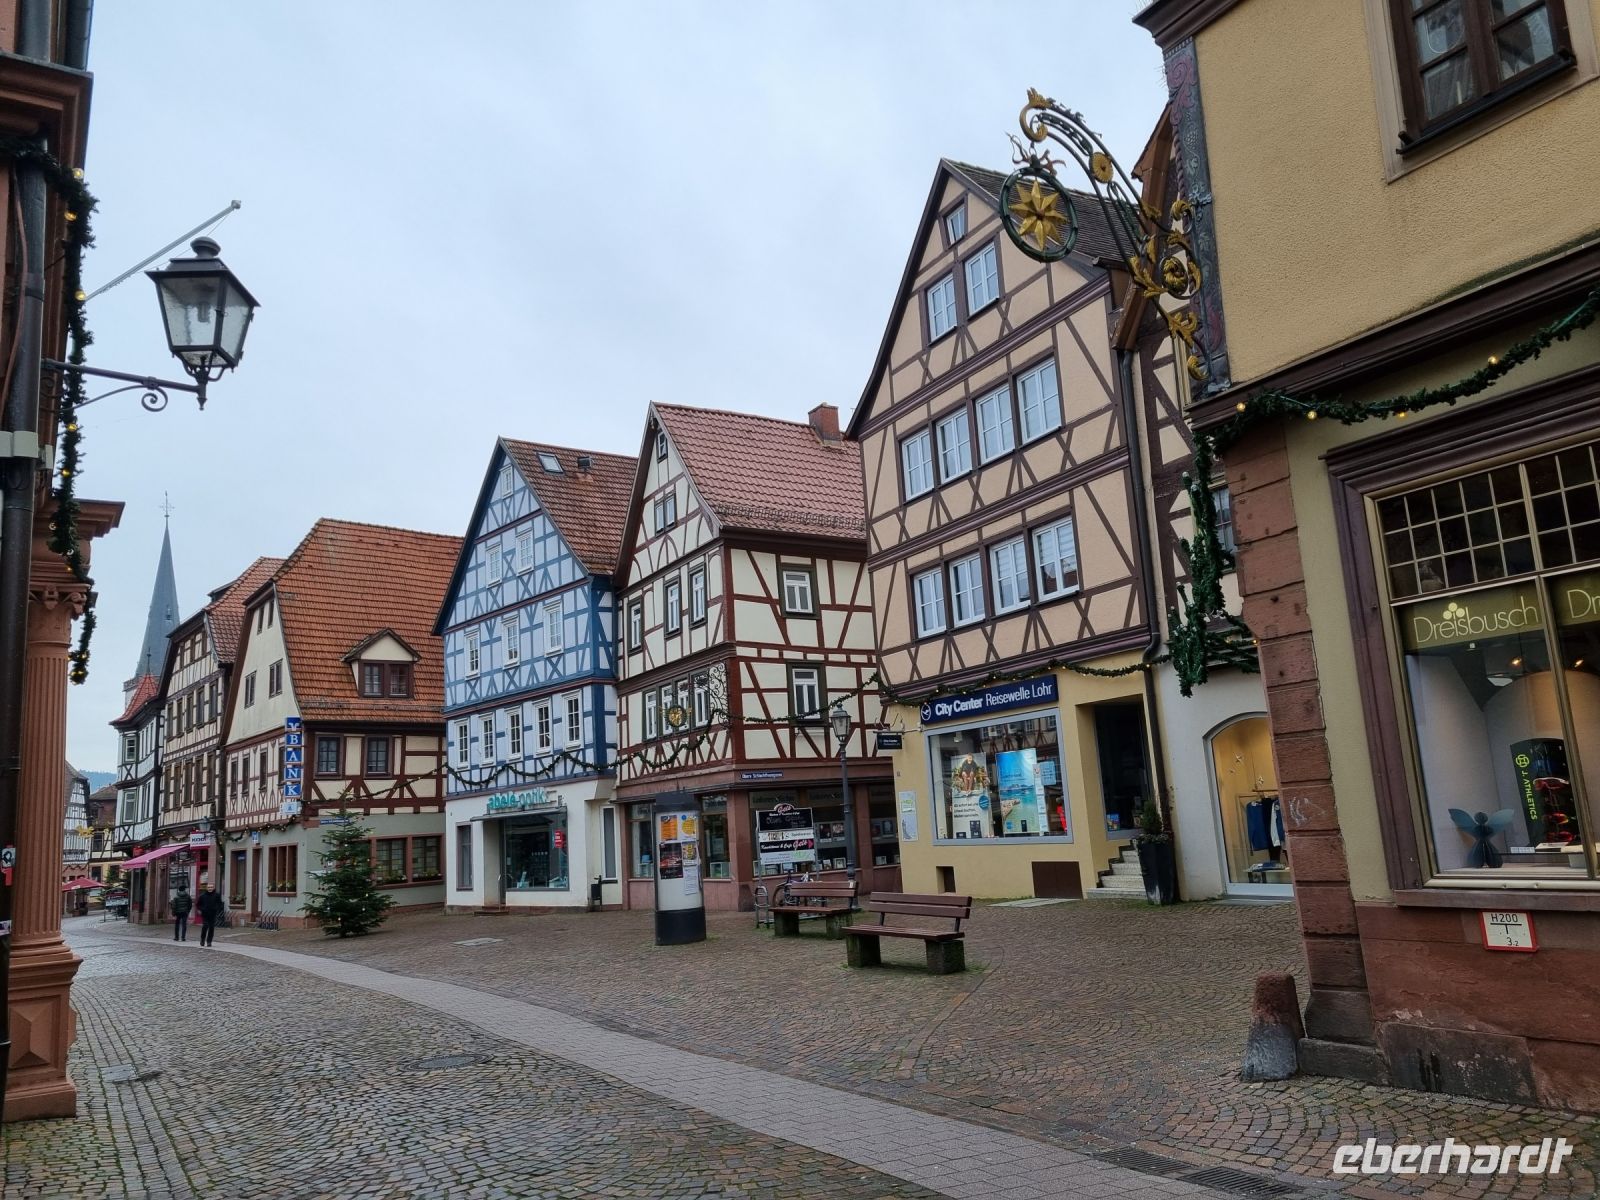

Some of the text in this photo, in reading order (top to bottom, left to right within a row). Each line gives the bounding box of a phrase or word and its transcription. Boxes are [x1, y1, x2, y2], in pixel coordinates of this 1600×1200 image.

[1413, 595, 1539, 643] Dreisbusch
[935, 682, 1053, 717] City Center Reisewelle Lohr
[287, 734, 299, 796] BANK
[1522, 778, 1538, 820] ATHLETICS
[1490, 912, 1518, 923] H200
